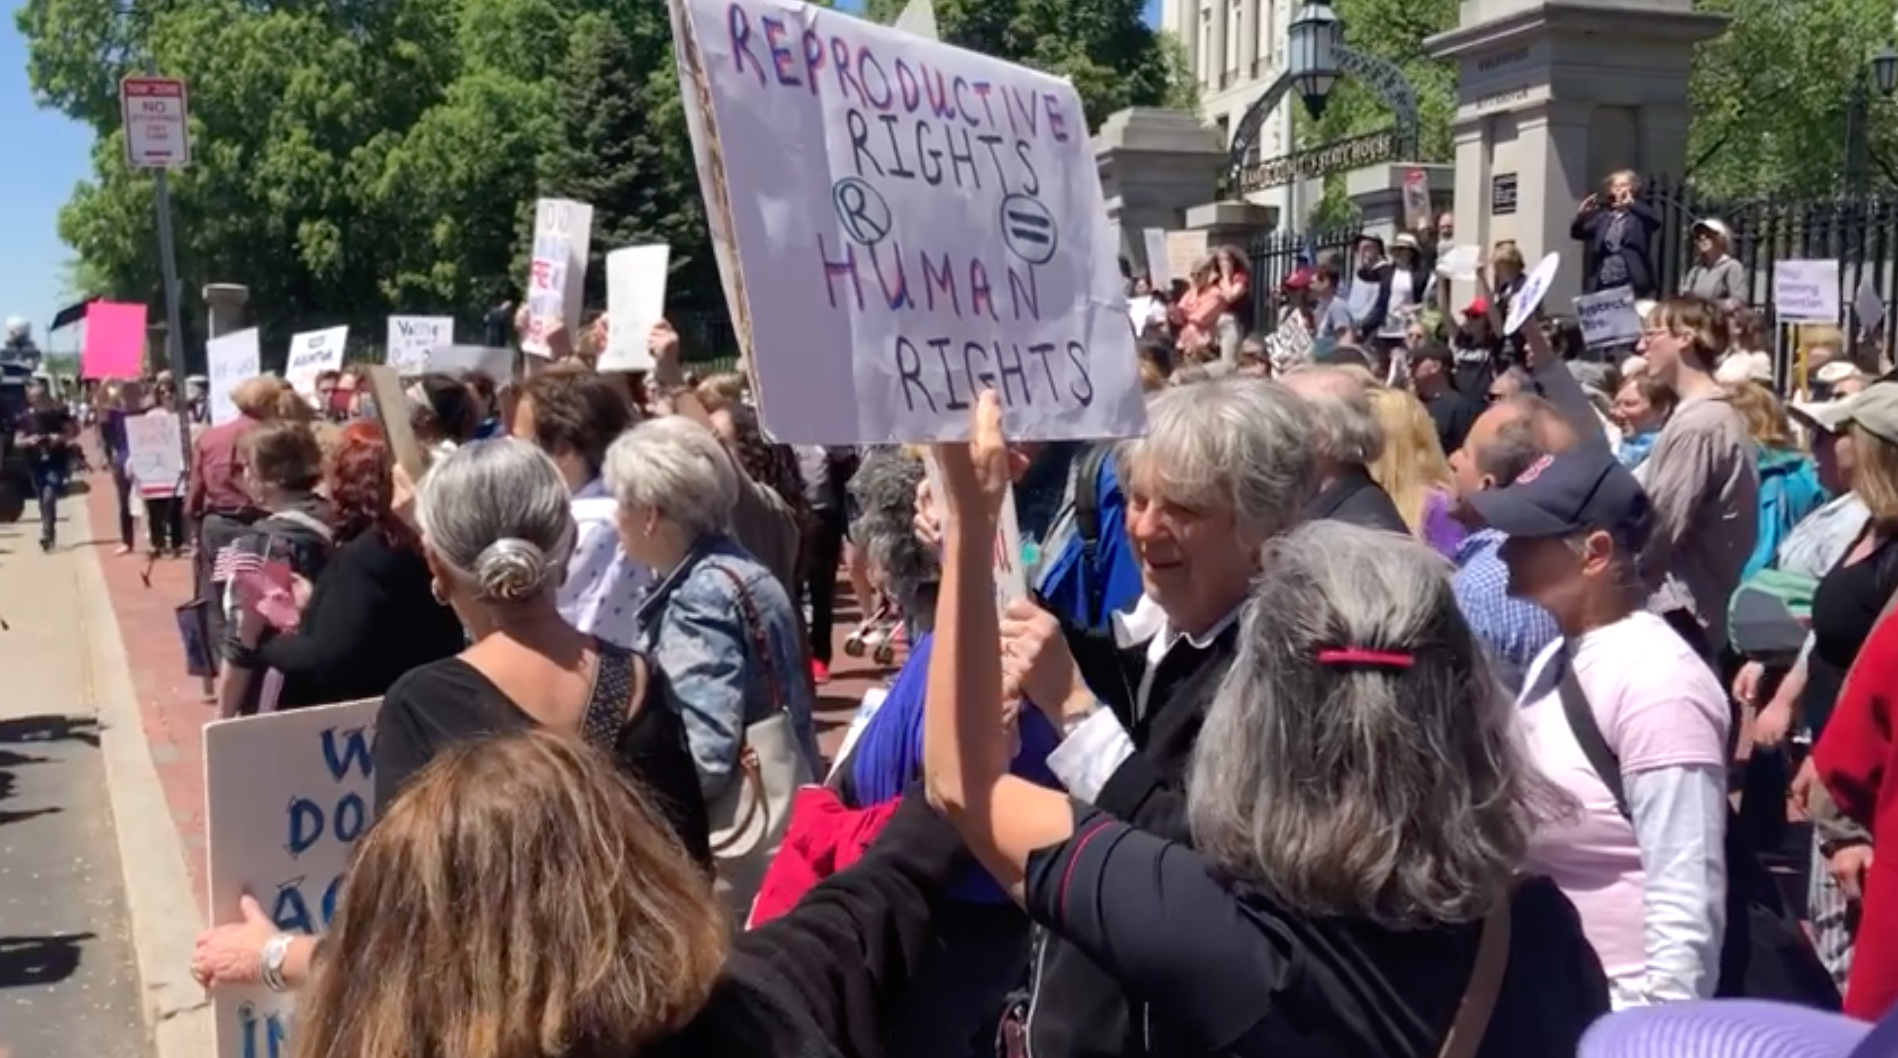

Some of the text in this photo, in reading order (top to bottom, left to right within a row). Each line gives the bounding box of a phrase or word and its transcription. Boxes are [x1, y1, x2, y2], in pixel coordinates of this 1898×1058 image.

[143, 101, 166, 113] NO
[727, 3, 1069, 143] REPRODUCTIVE
[846, 110, 1039, 197] RIGHTS
[818, 233, 1039, 322] HUMAN
[896, 336, 1094, 413] RIGHTS
